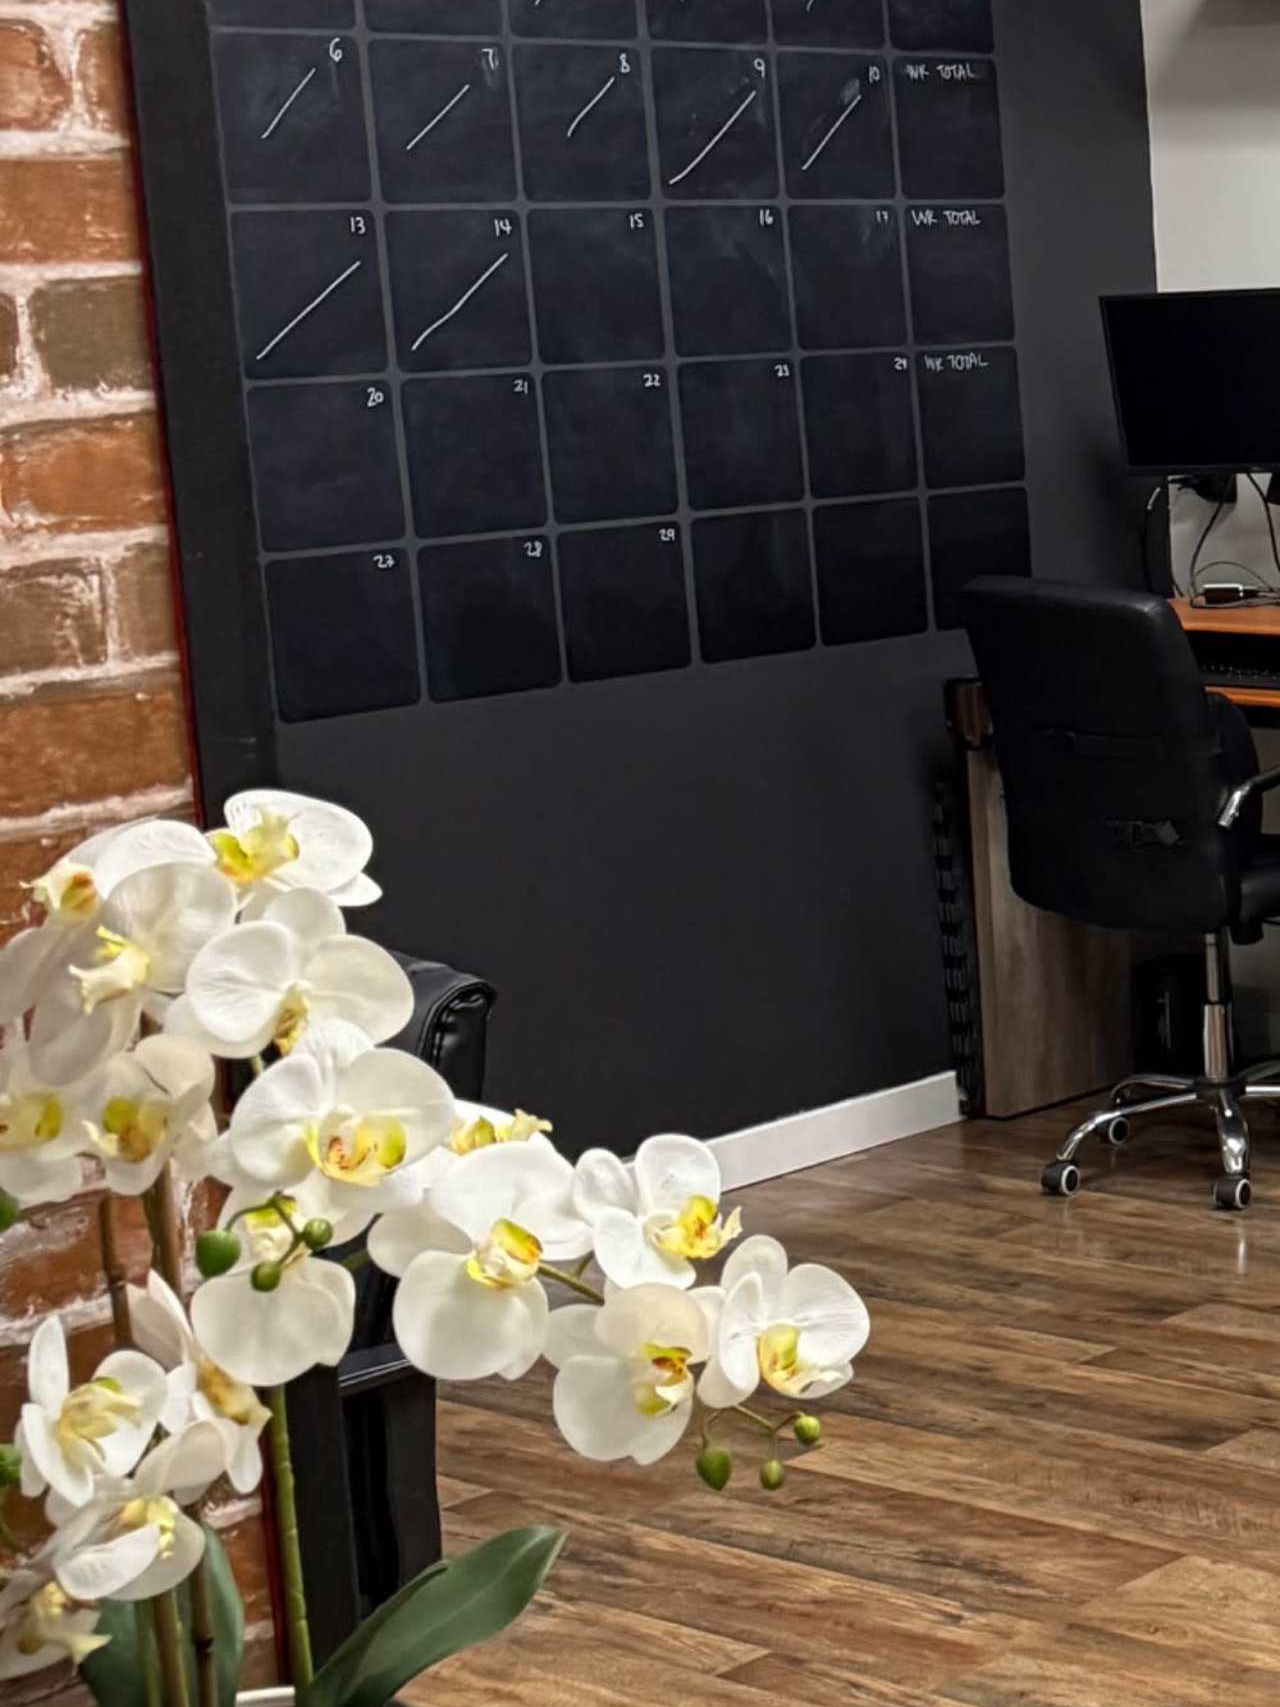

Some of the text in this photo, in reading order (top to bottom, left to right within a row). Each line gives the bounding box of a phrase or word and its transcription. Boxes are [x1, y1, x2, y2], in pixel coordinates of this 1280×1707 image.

[329, 37, 343, 63] 6
[481, 47, 499, 70] 7
[619, 53, 631, 74] 8
[753, 57, 766, 79] 9
[935, 63, 976, 80] TOTAL
[350, 216, 366, 235] 13
[493, 218, 513, 237] 14
[629, 213, 644, 229] 15
[759, 208, 774, 226] 16
[942, 209, 981, 225] TOTAL
[946, 352, 989, 371] TOTAL
[367, 386, 384, 407] 20
[513, 379, 529, 395] 21
[643, 373, 661, 388] 22
[372, 554, 395, 569] 27
[658, 528, 676, 542] 29
